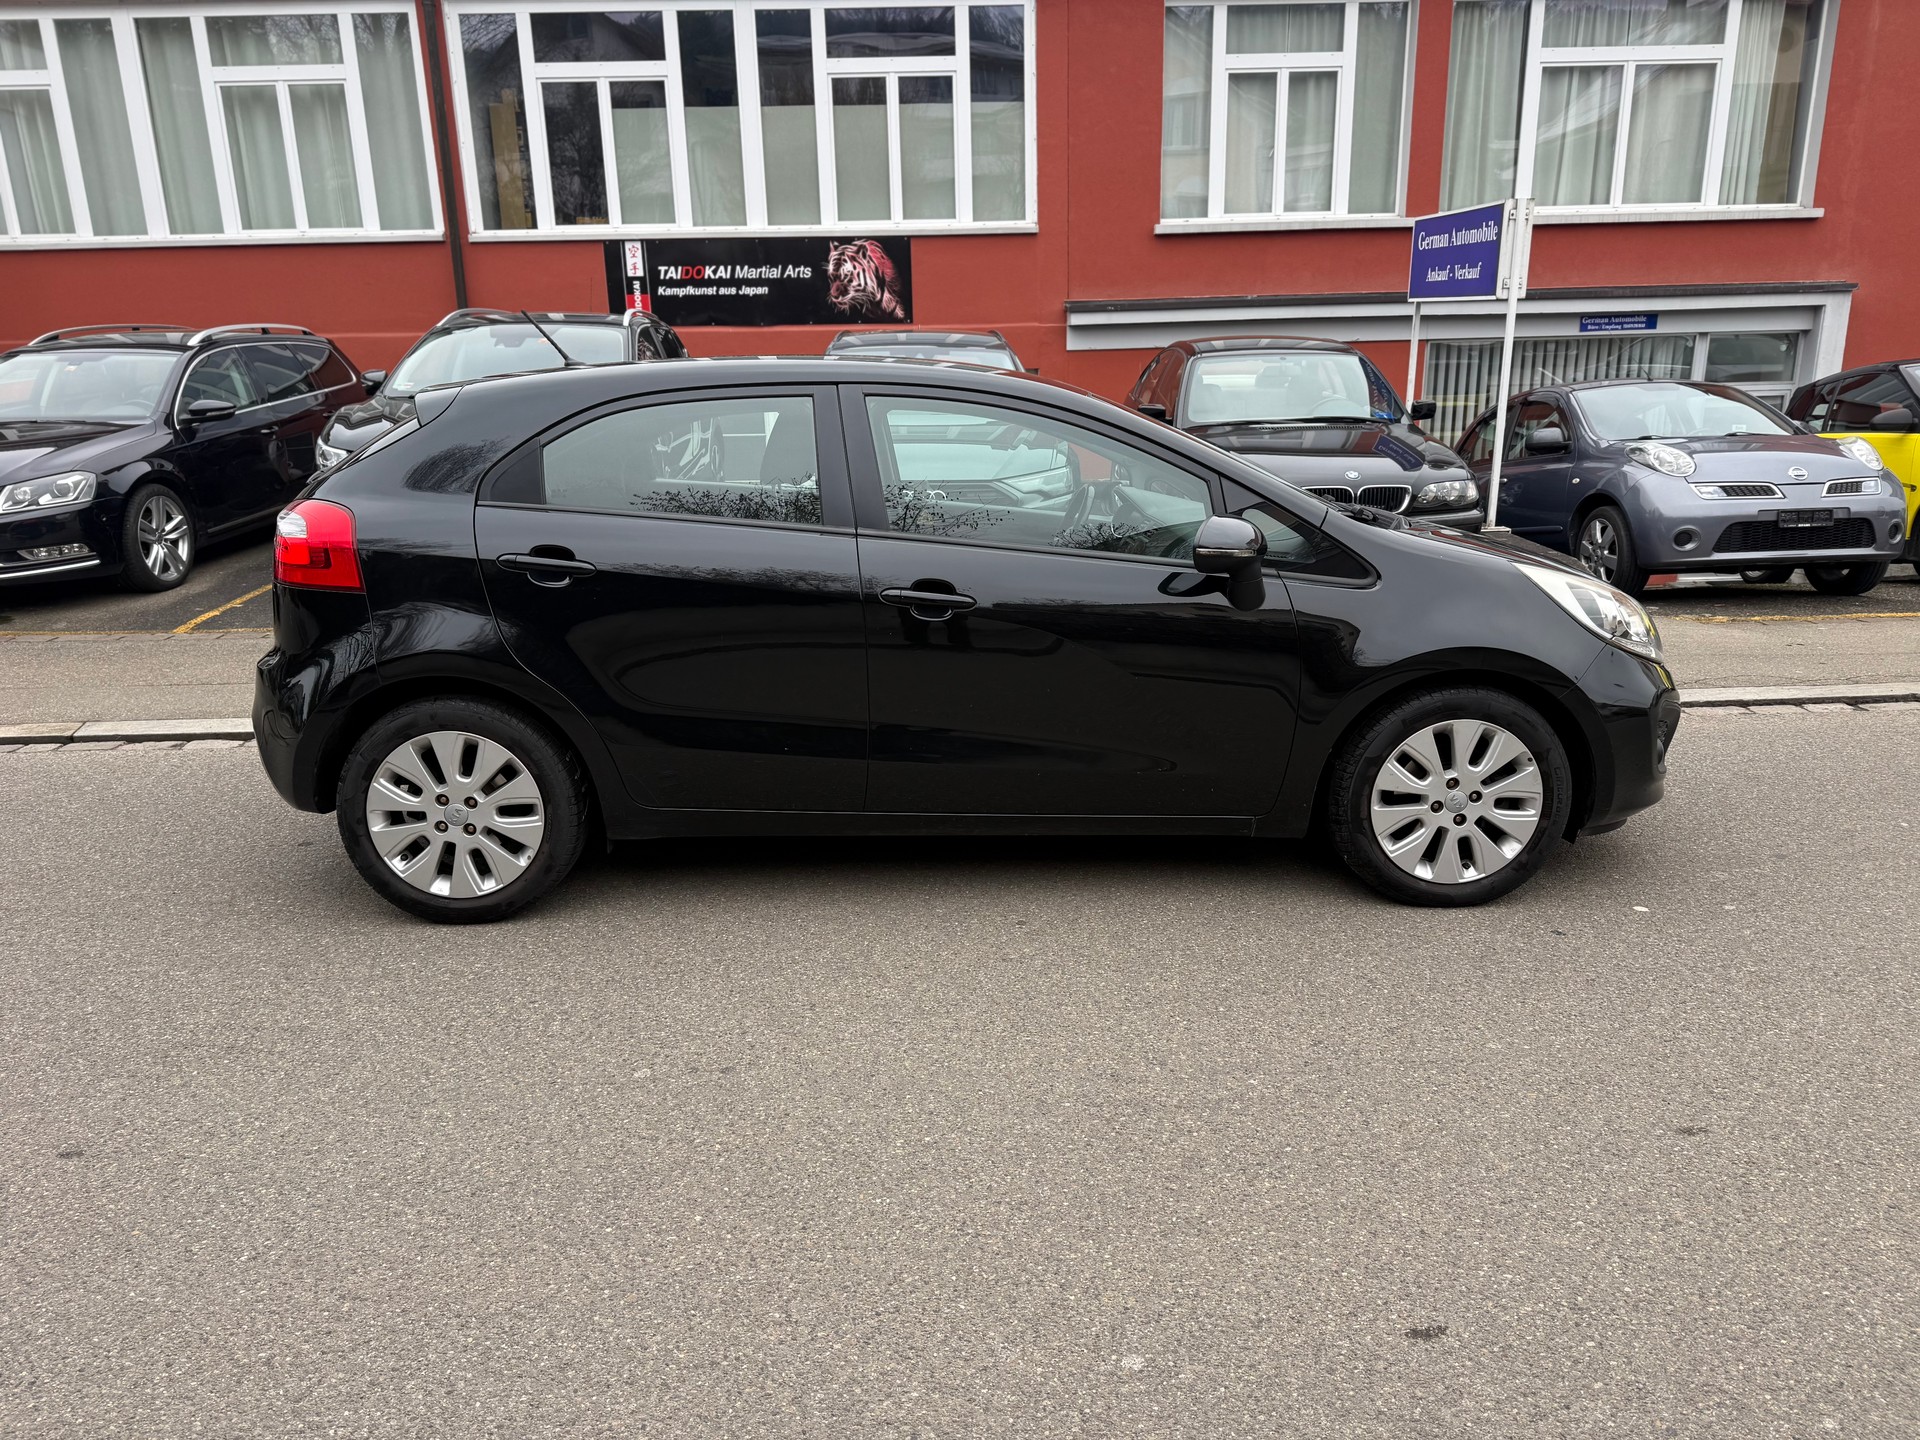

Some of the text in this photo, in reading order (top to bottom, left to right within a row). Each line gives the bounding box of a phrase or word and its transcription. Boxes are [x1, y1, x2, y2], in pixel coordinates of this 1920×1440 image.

[1418, 220, 1498, 250] German Automobile
[628, 244, 640, 275] 空手
[657, 264, 812, 280] TAIDOKAI Martial Arts
[1425, 265, 1450, 282] Ankauf
[1454, 262, 1482, 280] Verkauf
[632, 280, 643, 315] IDOKAI
[657, 285, 769, 298] Kampfkunst aus Japan
[1582, 315, 1648, 324] German Automobile
